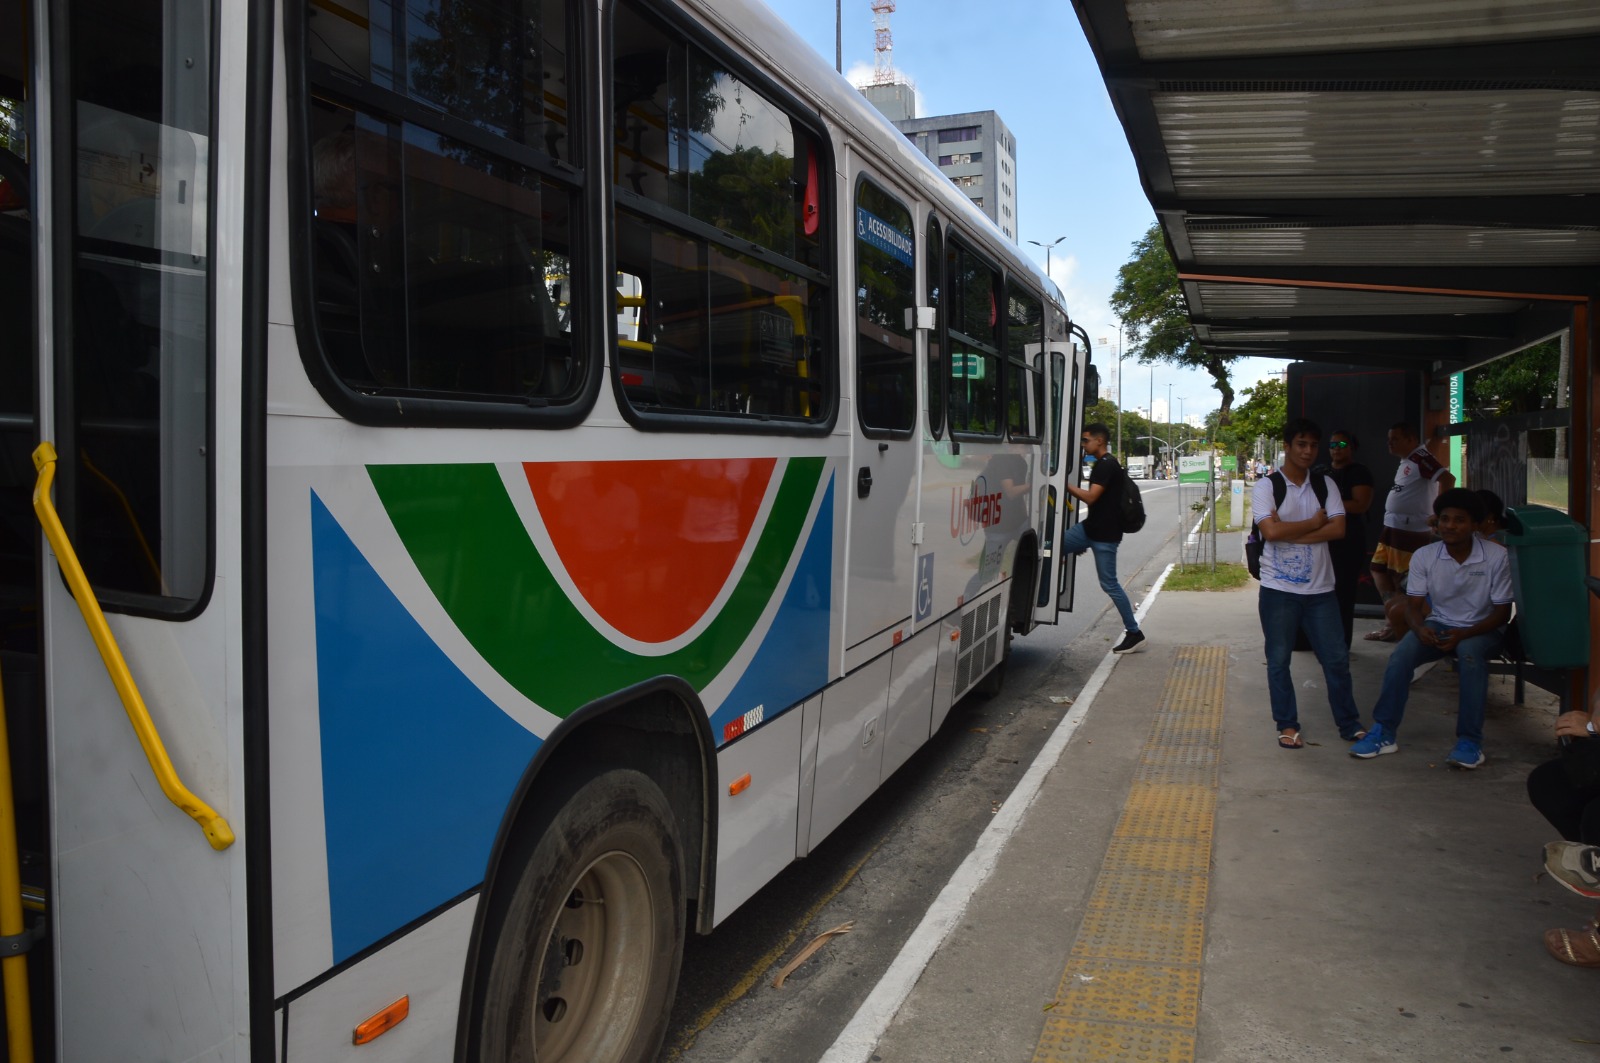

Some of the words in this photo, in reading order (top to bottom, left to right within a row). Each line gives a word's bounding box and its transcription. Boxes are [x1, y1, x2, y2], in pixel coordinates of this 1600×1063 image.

[868, 216, 912, 256] ACESSIBILIDADE
[1450, 375, 1459, 396] VIDA
[1450, 397, 1459, 425] SPAÇO
[950, 484, 1003, 539] Unitrans
